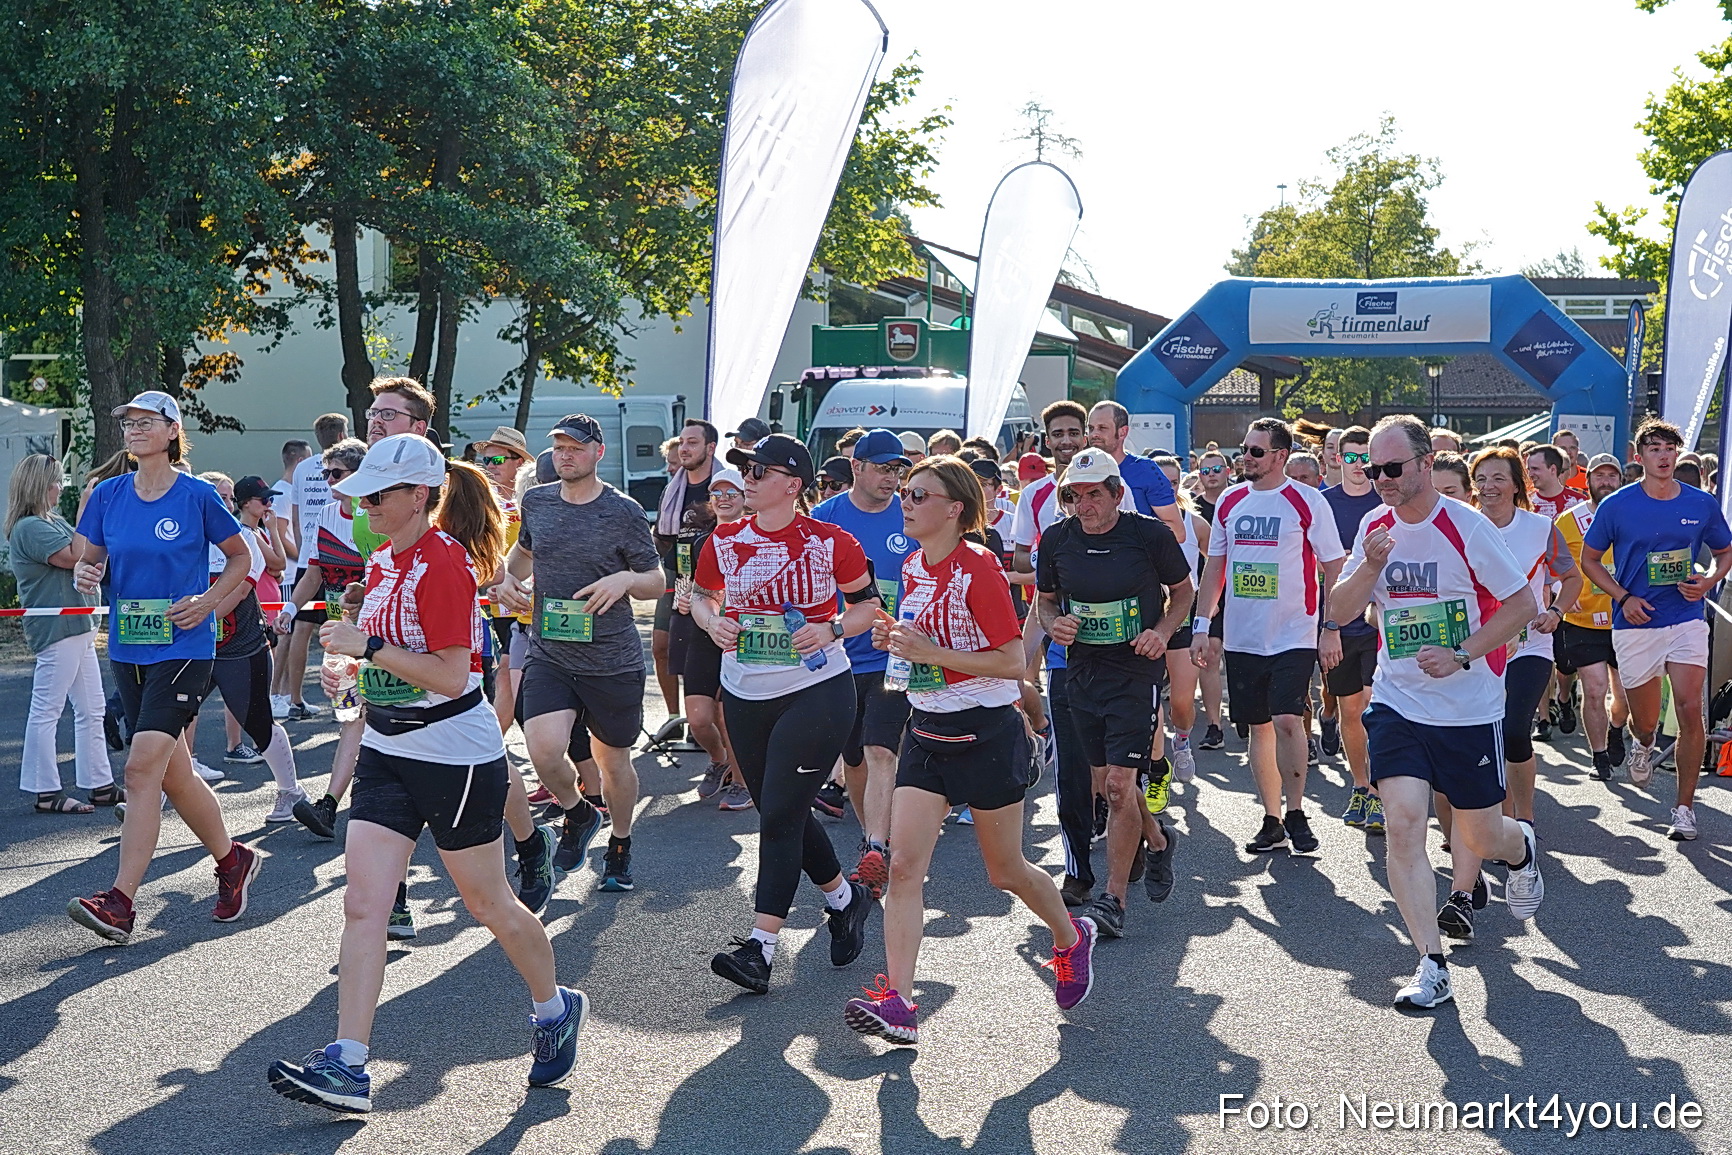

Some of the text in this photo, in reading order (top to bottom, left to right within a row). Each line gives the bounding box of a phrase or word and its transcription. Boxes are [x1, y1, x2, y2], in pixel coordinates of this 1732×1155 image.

[1341, 314, 1431, 332] firmenlauf
[1170, 343, 1218, 354] Fischer
[1683, 336, 1725, 449] ischer-automobile.de
[826, 405, 866, 415] abavent
[1234, 514, 1282, 536] OM
[1384, 560, 1438, 587] OM
[1660, 561, 1683, 574] 456
[1242, 574, 1266, 588] 509
[125, 614, 163, 630] 1746
[560, 613, 569, 628] 2
[1080, 617, 1110, 632] 296
[1399, 622, 1432, 642] 500
[1439, 623, 1448, 646] 2022
[746, 631, 790, 650] 1106
[743, 648, 791, 657] Schwarz Melanie
[931, 665, 942, 683] 202
[366, 687, 387, 697] Stiegler
[388, 687, 412, 697] Bettina
